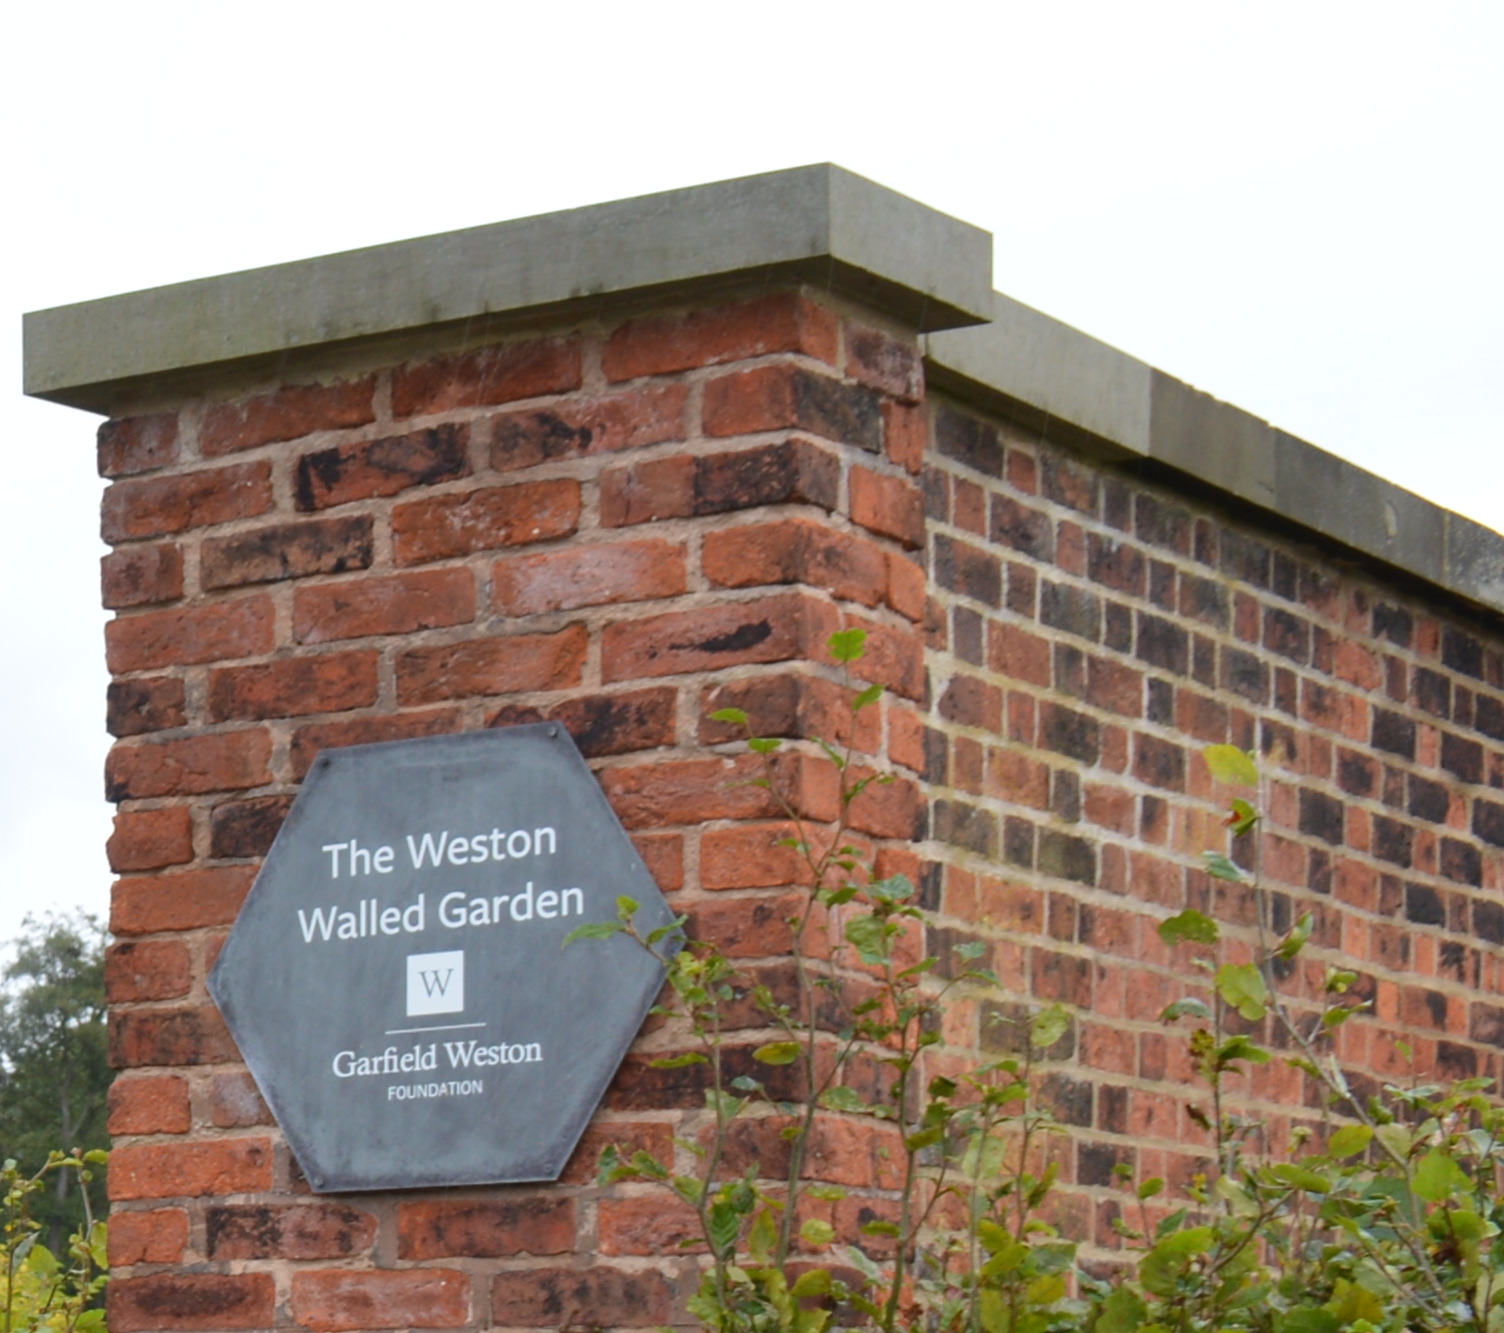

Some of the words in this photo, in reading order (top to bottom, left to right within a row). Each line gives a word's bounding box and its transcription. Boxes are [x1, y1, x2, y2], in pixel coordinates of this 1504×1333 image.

[322, 839, 395, 879] The
[406, 826, 556, 869] Weston
[297, 893, 425, 943] Walled
[438, 881, 584, 929] Garden
[418, 968, 454, 998] W
[332, 1043, 437, 1078] Garfield
[443, 1040, 543, 1068] Weston
[387, 1080, 483, 1101] FOUNDATION
